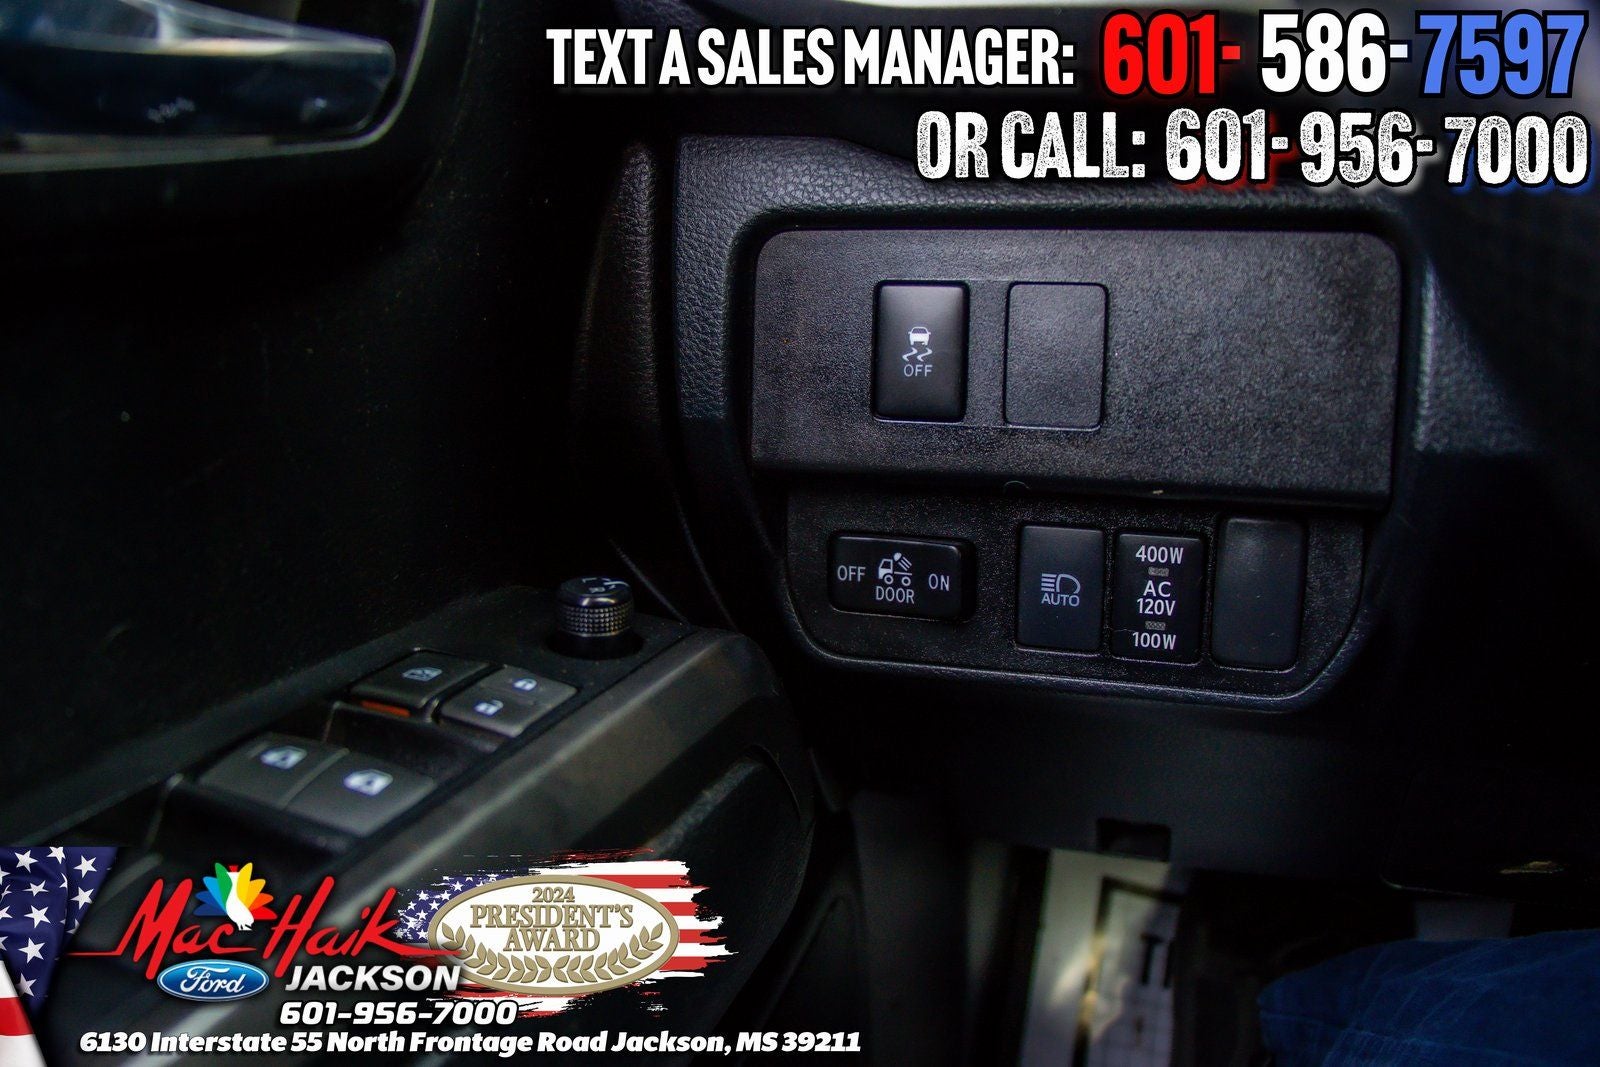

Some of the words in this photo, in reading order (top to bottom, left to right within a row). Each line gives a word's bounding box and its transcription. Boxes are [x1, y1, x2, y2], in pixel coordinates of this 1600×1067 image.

[903, 364, 933, 377] OFF
[1135, 545, 1184, 564] 400W
[837, 565, 866, 582] OFF
[928, 573, 950, 591] ON
[875, 586, 915, 604] DOOR
[1143, 580, 1172, 598] AC
[1041, 594, 1080, 607] AUTO
[1136, 598, 1176, 617] 120V
[1131, 632, 1177, 650] 100W
